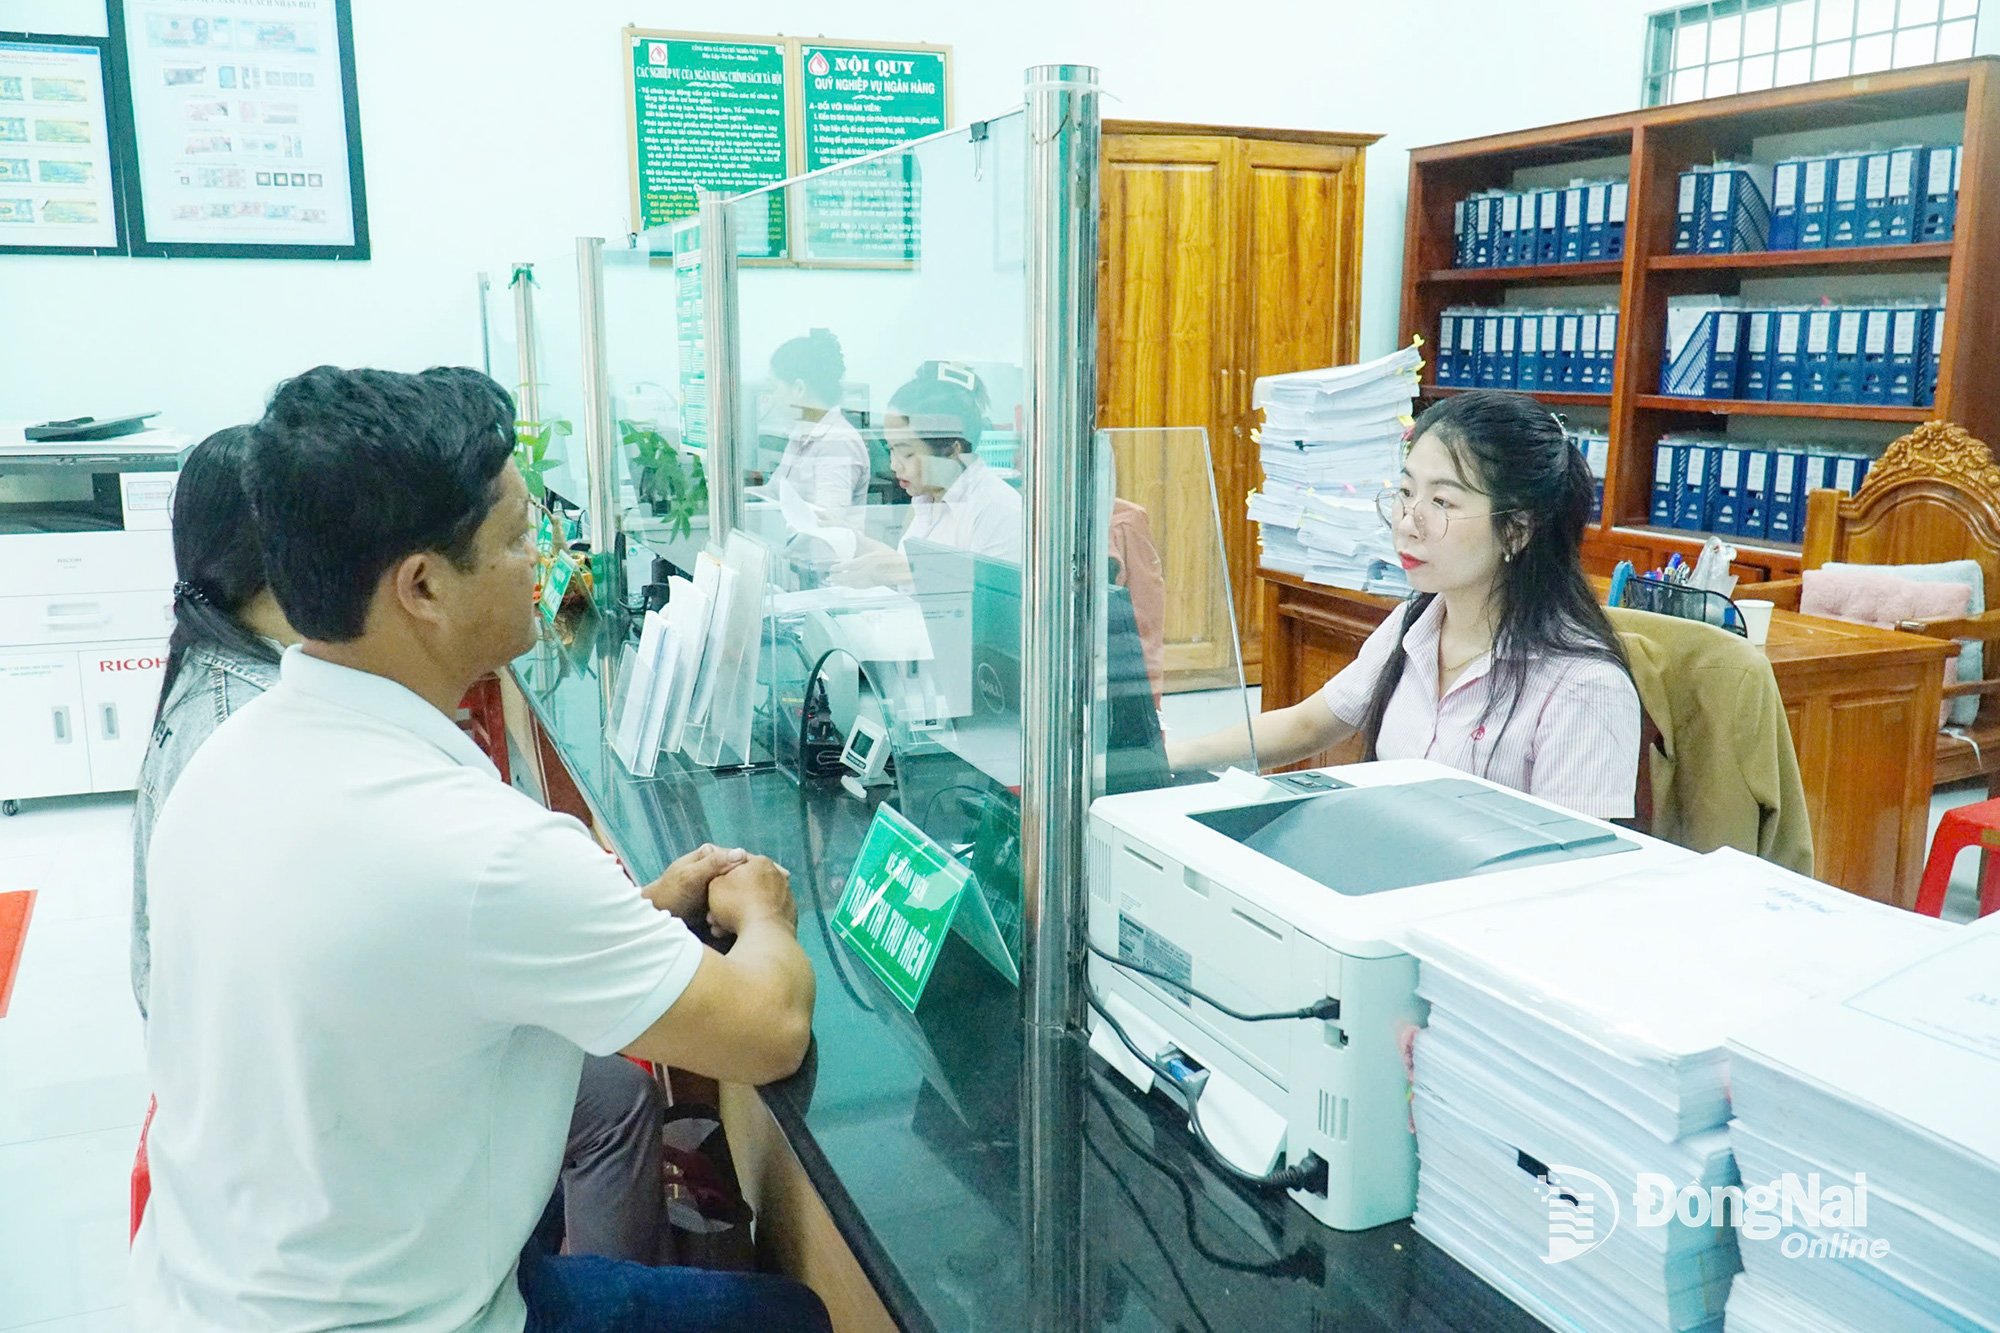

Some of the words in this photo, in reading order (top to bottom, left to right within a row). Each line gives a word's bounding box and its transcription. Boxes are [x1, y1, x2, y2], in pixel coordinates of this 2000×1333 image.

[834, 54, 870, 76] NỘI
[874, 58, 914, 78] QUY
[836, 77, 868, 93] NGHIỆP
[870, 80, 882, 94] VỤ
[884, 78, 907, 93] NGÂN
[910, 80, 936, 94] HÀNG
[867, 895, 892, 950] THỊ
[880, 908, 909, 958] THU
